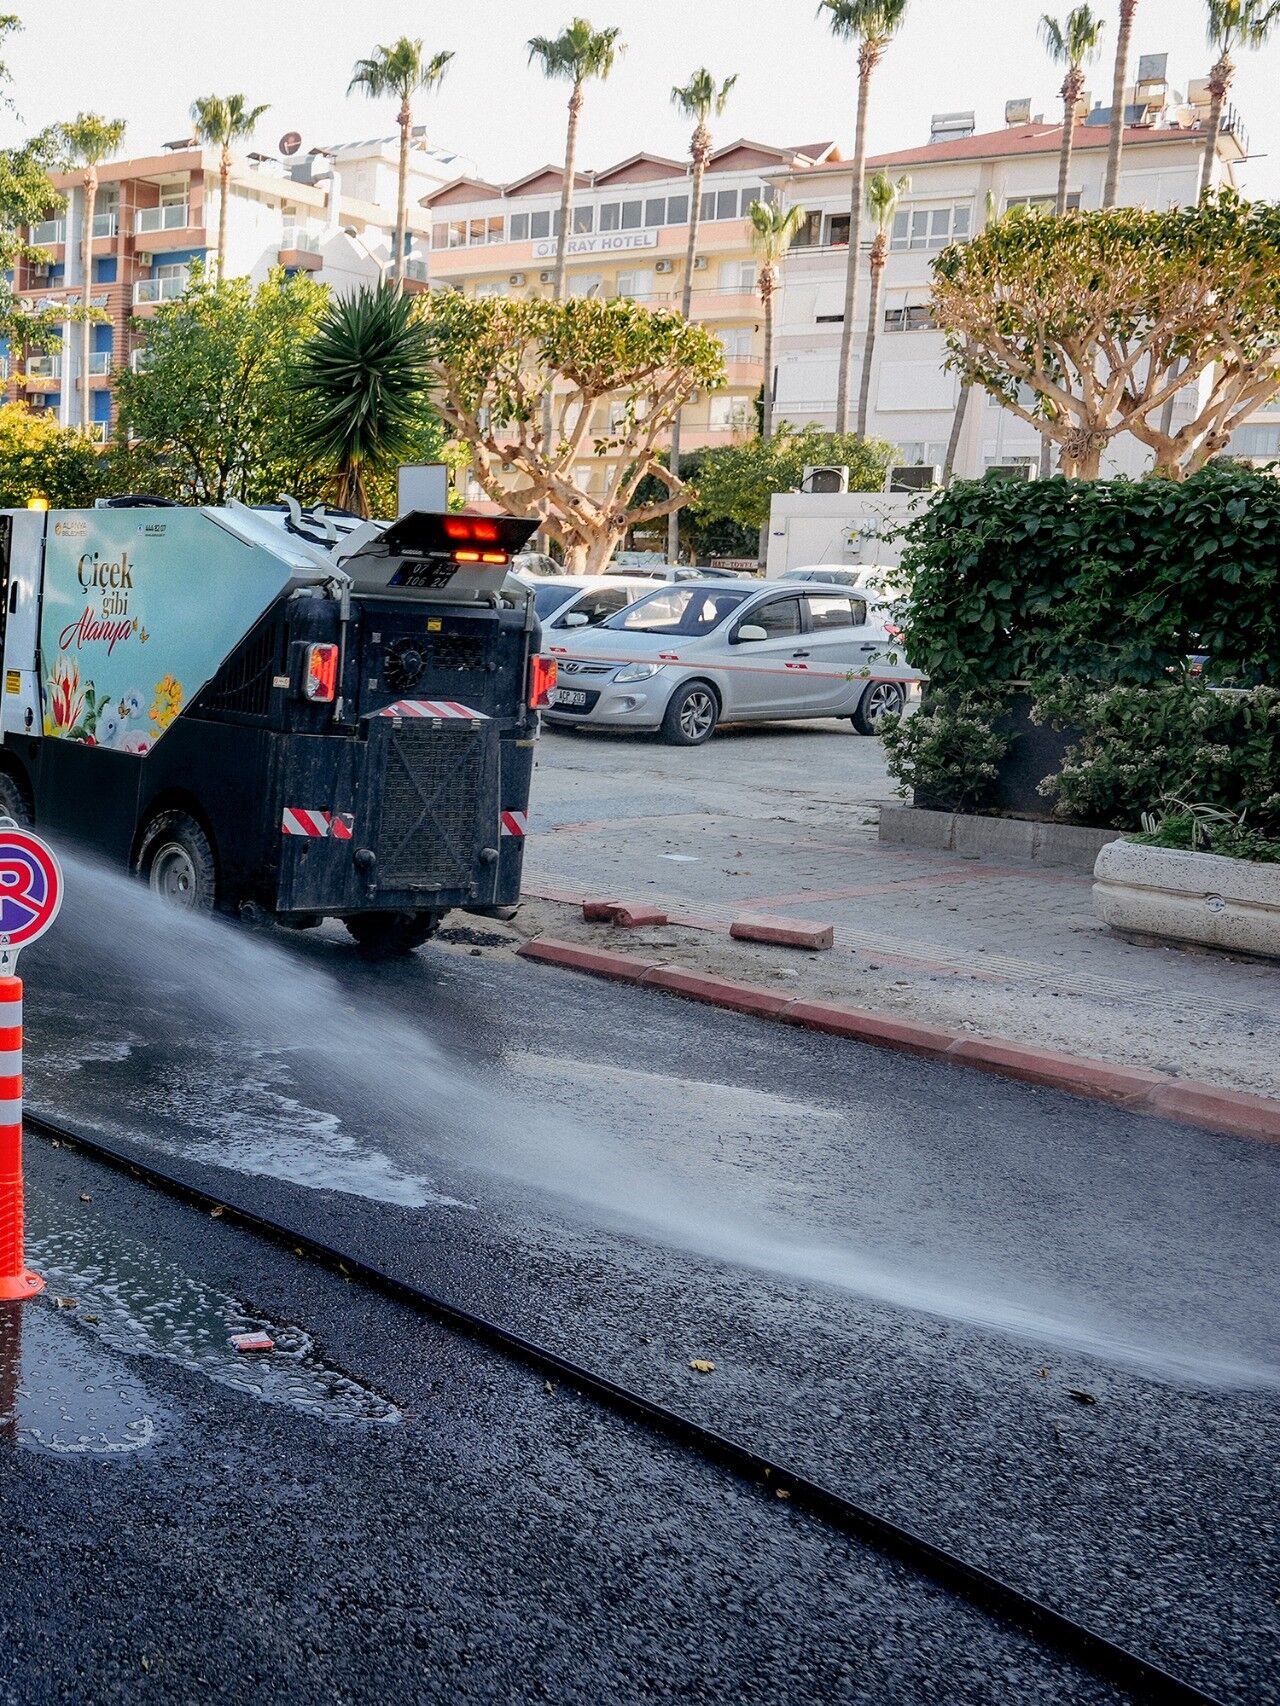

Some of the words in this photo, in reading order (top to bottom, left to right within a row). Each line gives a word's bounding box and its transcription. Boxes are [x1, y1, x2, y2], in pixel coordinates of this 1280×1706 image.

[551, 238, 597, 254] MRAY
[602, 235, 652, 249] HOTEL
[77, 552, 134, 595] Çiçek
[412, 563, 429, 573] 07
[101, 591, 128, 619] gibi
[59, 606, 132, 657] Alanya
